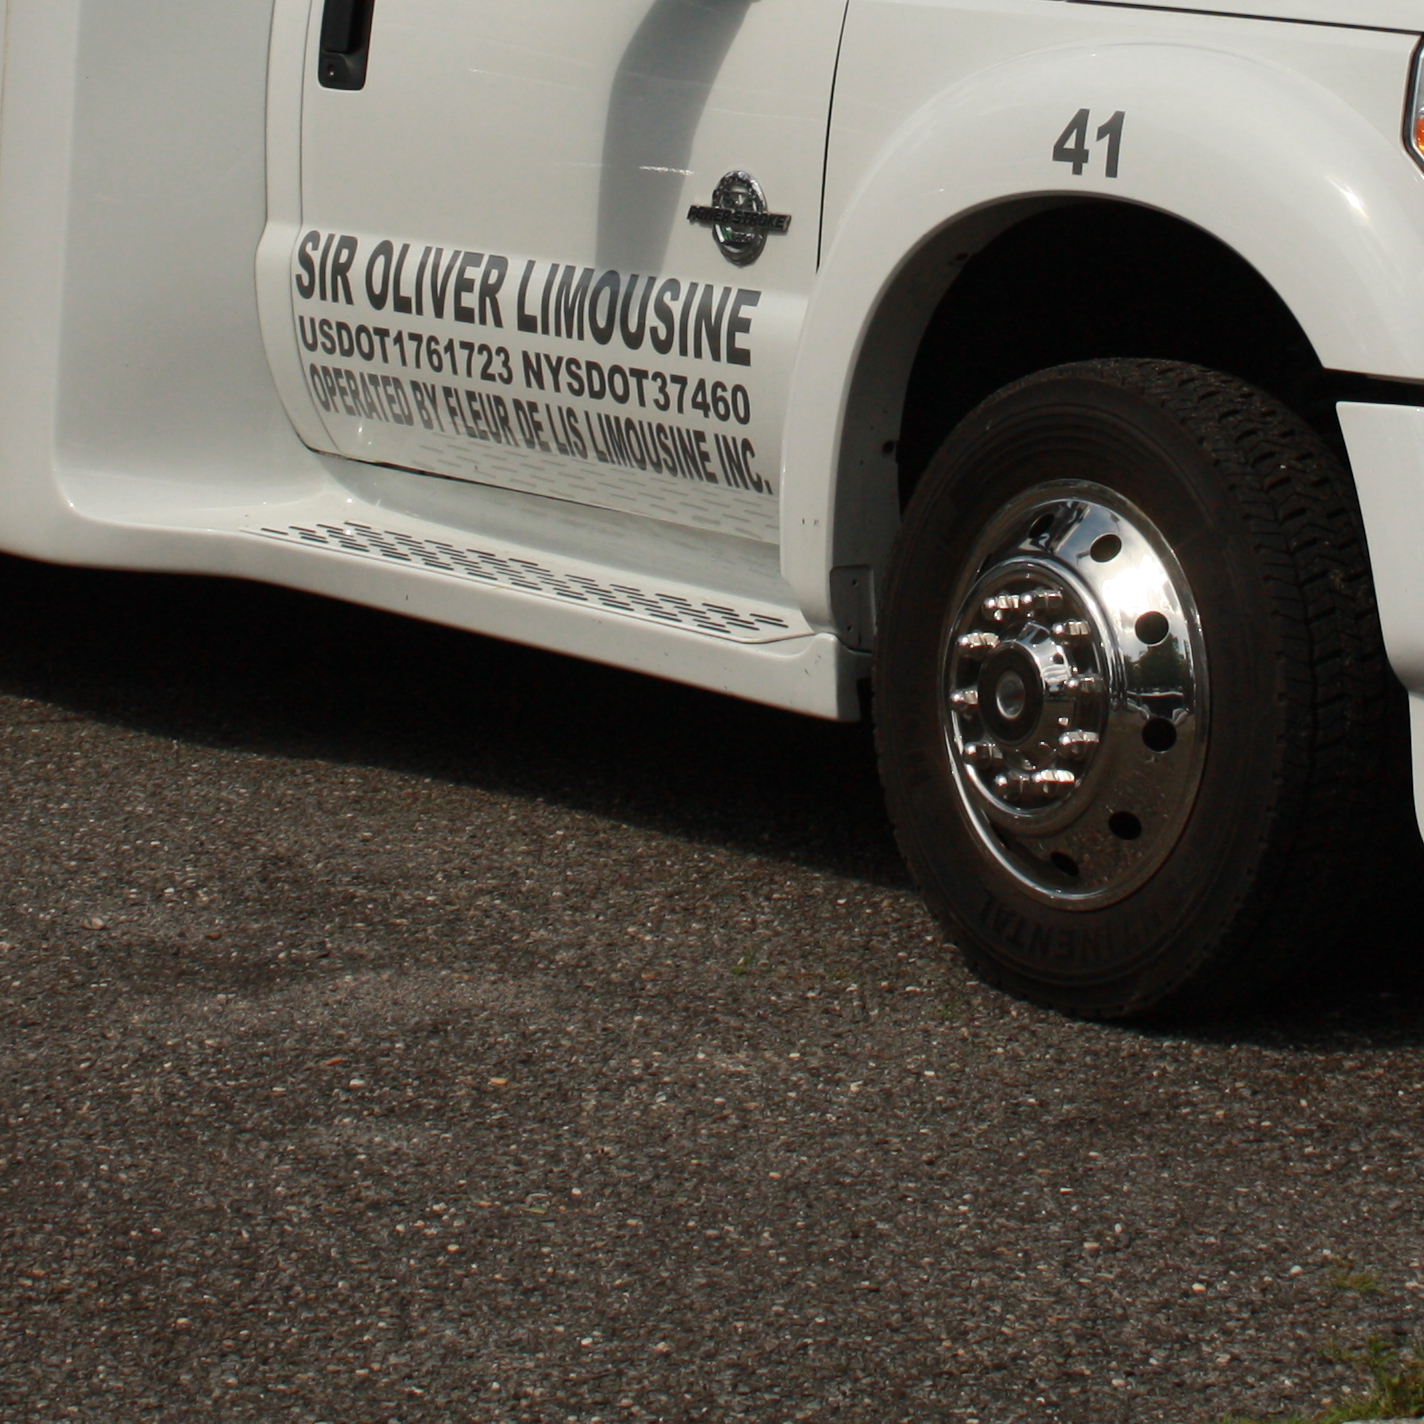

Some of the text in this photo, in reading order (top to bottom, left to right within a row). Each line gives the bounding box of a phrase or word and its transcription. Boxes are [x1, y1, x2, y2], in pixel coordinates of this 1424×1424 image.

[1052, 108, 1126, 178] 41
[294, 230, 763, 367] SIR OLIVER LIMOUSINE
[298, 314, 751, 425] USDOT1761723 NYSDOT37460
[308, 363, 774, 496] OPERATED BY FLEUR DE LIS LIMOUSINE INC.
